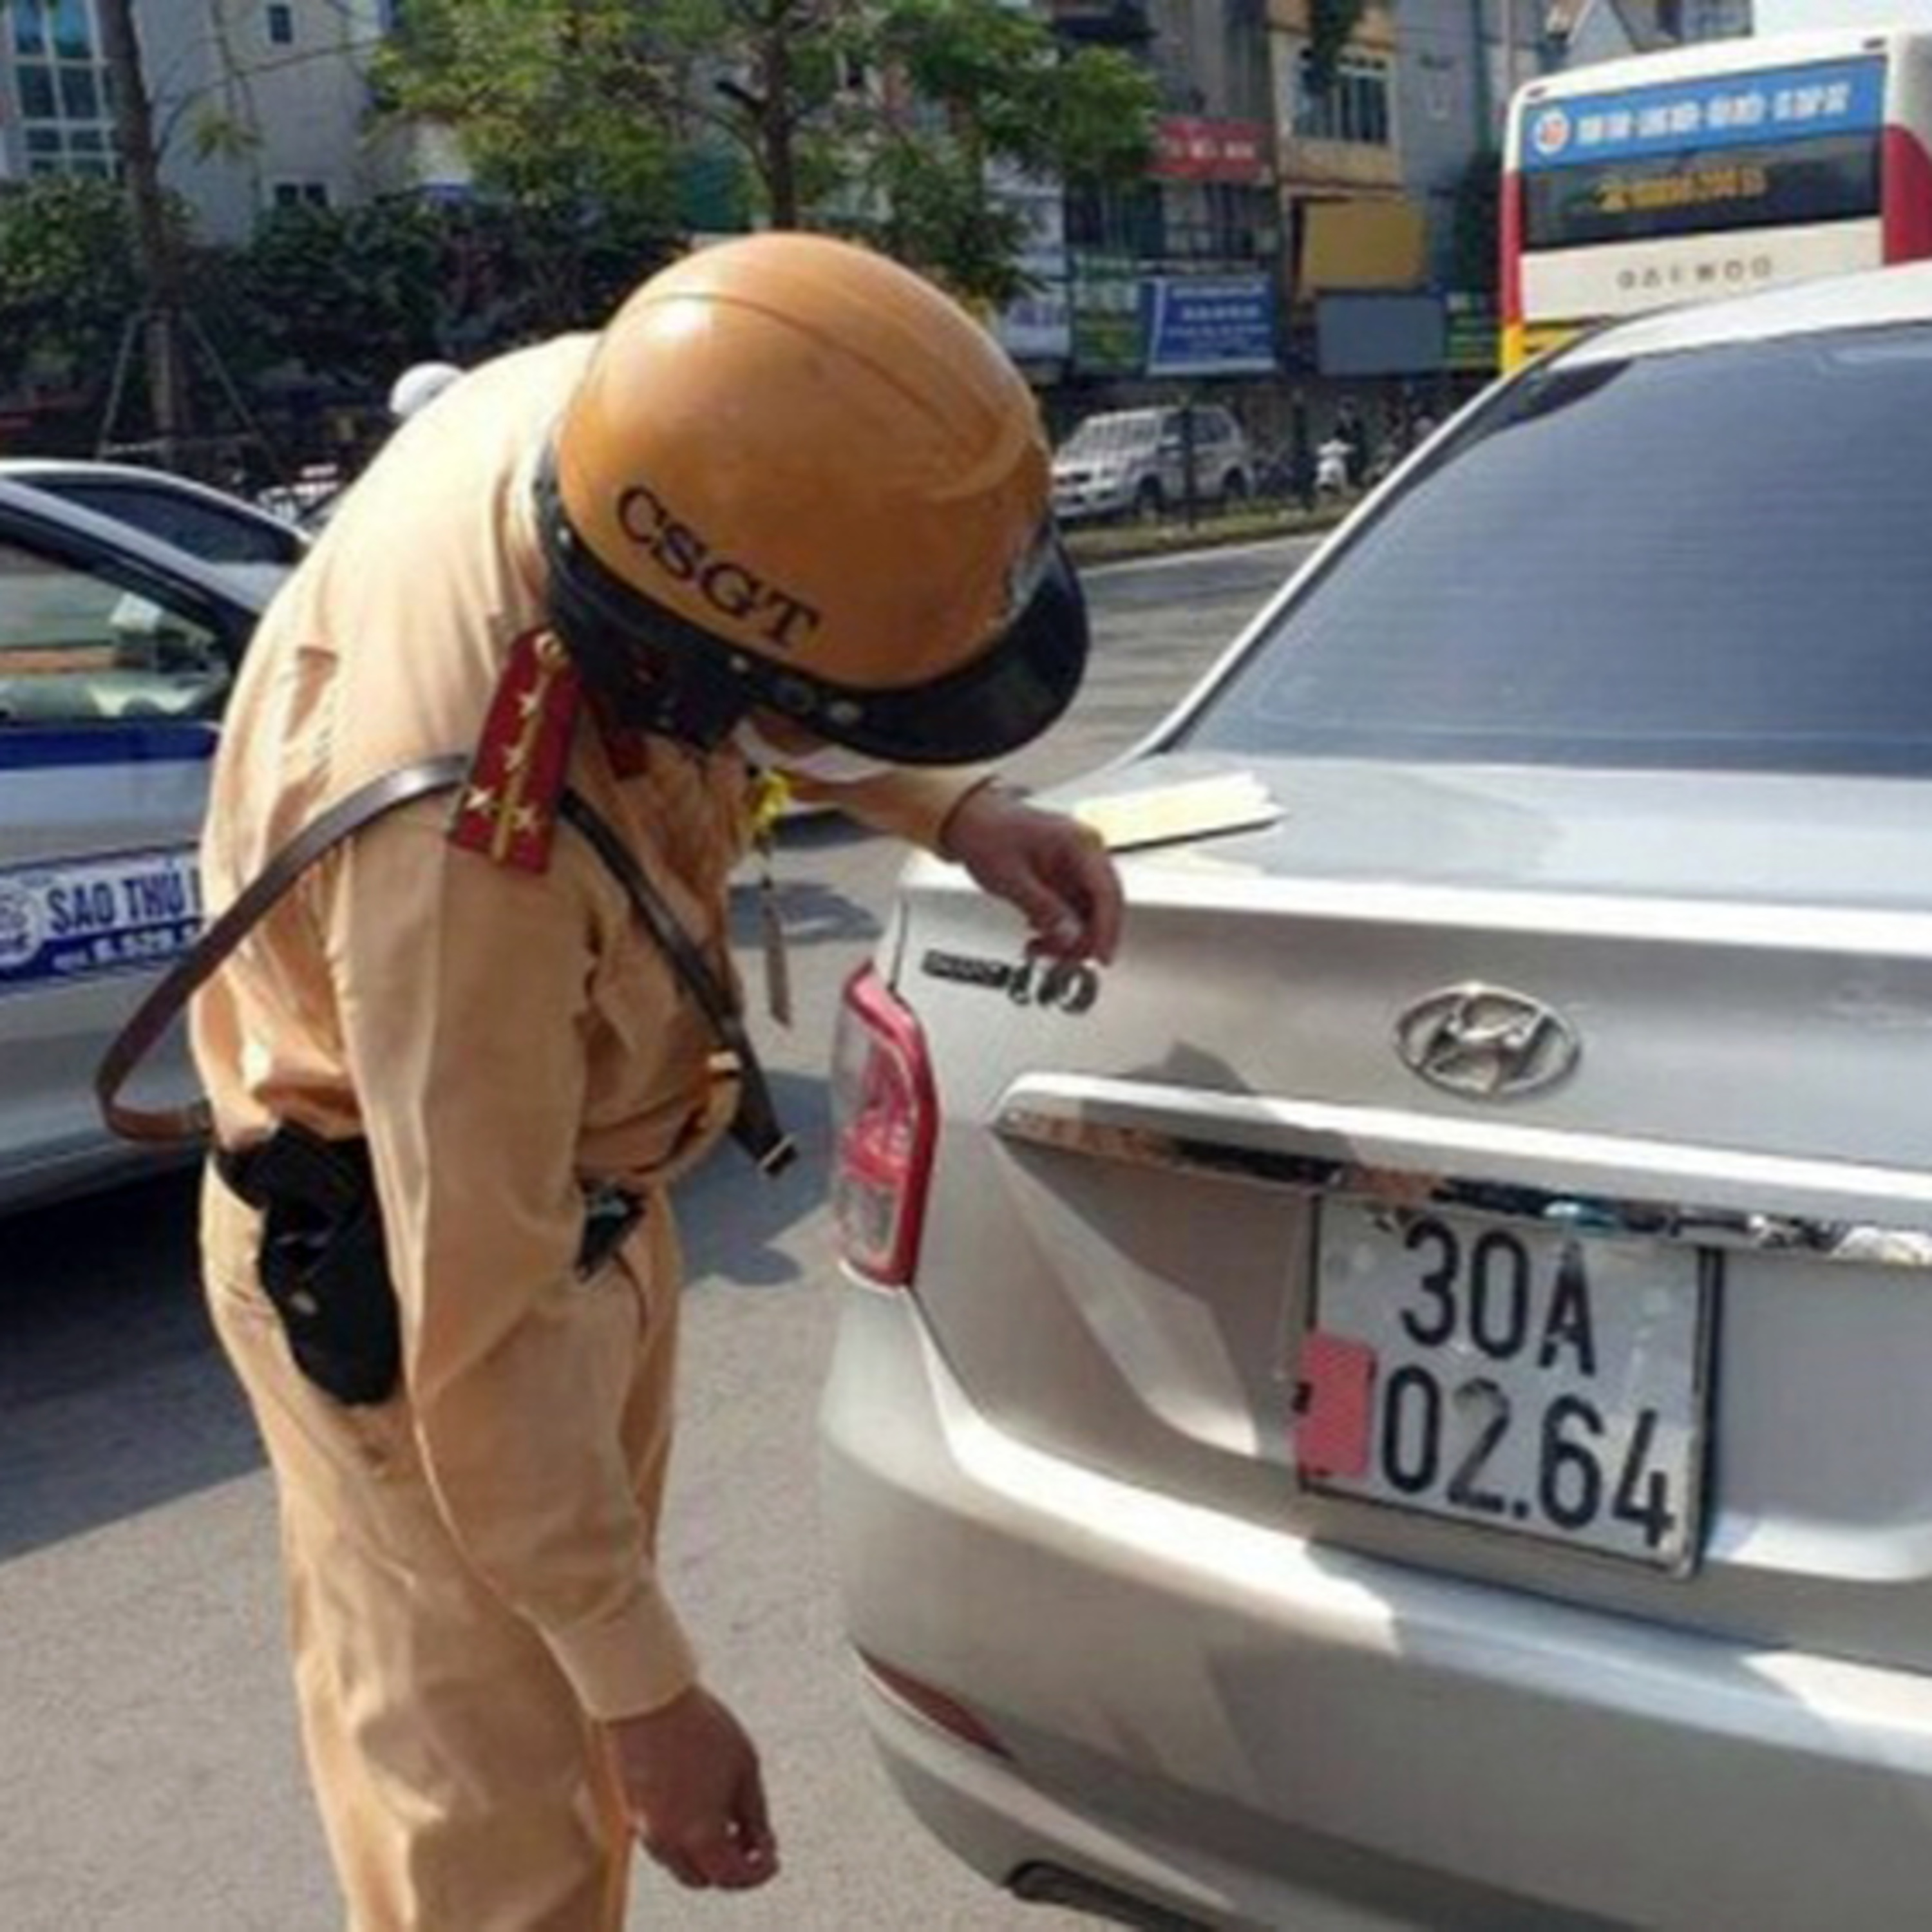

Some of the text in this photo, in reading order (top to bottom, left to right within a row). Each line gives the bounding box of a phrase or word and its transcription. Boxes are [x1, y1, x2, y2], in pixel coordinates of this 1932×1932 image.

[617, 484, 820, 647] CSGT
[48, 881, 116, 934] SAO
[1399, 1216, 1597, 1378] 30A
[1314, 1362, 1678, 1548] 02.64
